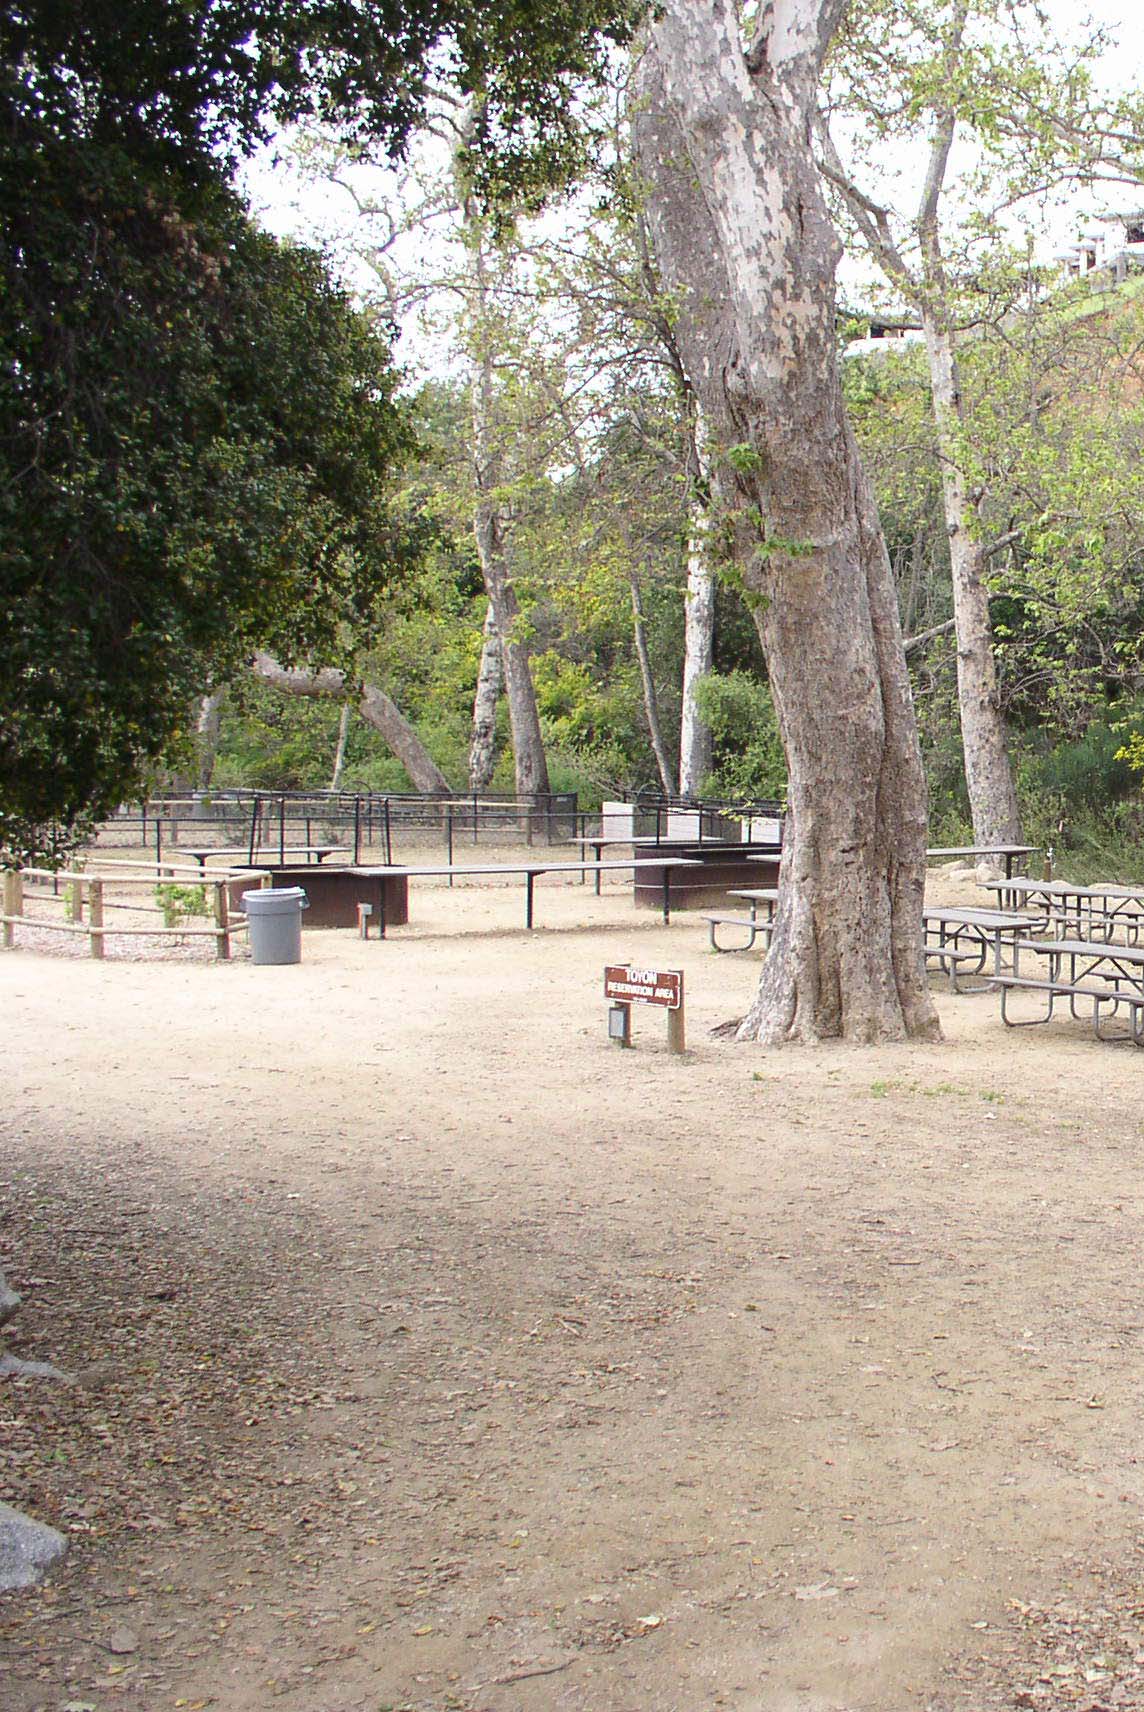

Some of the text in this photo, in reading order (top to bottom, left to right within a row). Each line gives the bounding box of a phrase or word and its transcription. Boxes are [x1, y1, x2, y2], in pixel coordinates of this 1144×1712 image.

[625, 969, 657, 984] TOYON
[607, 981, 674, 999] RESERVATION AREA
